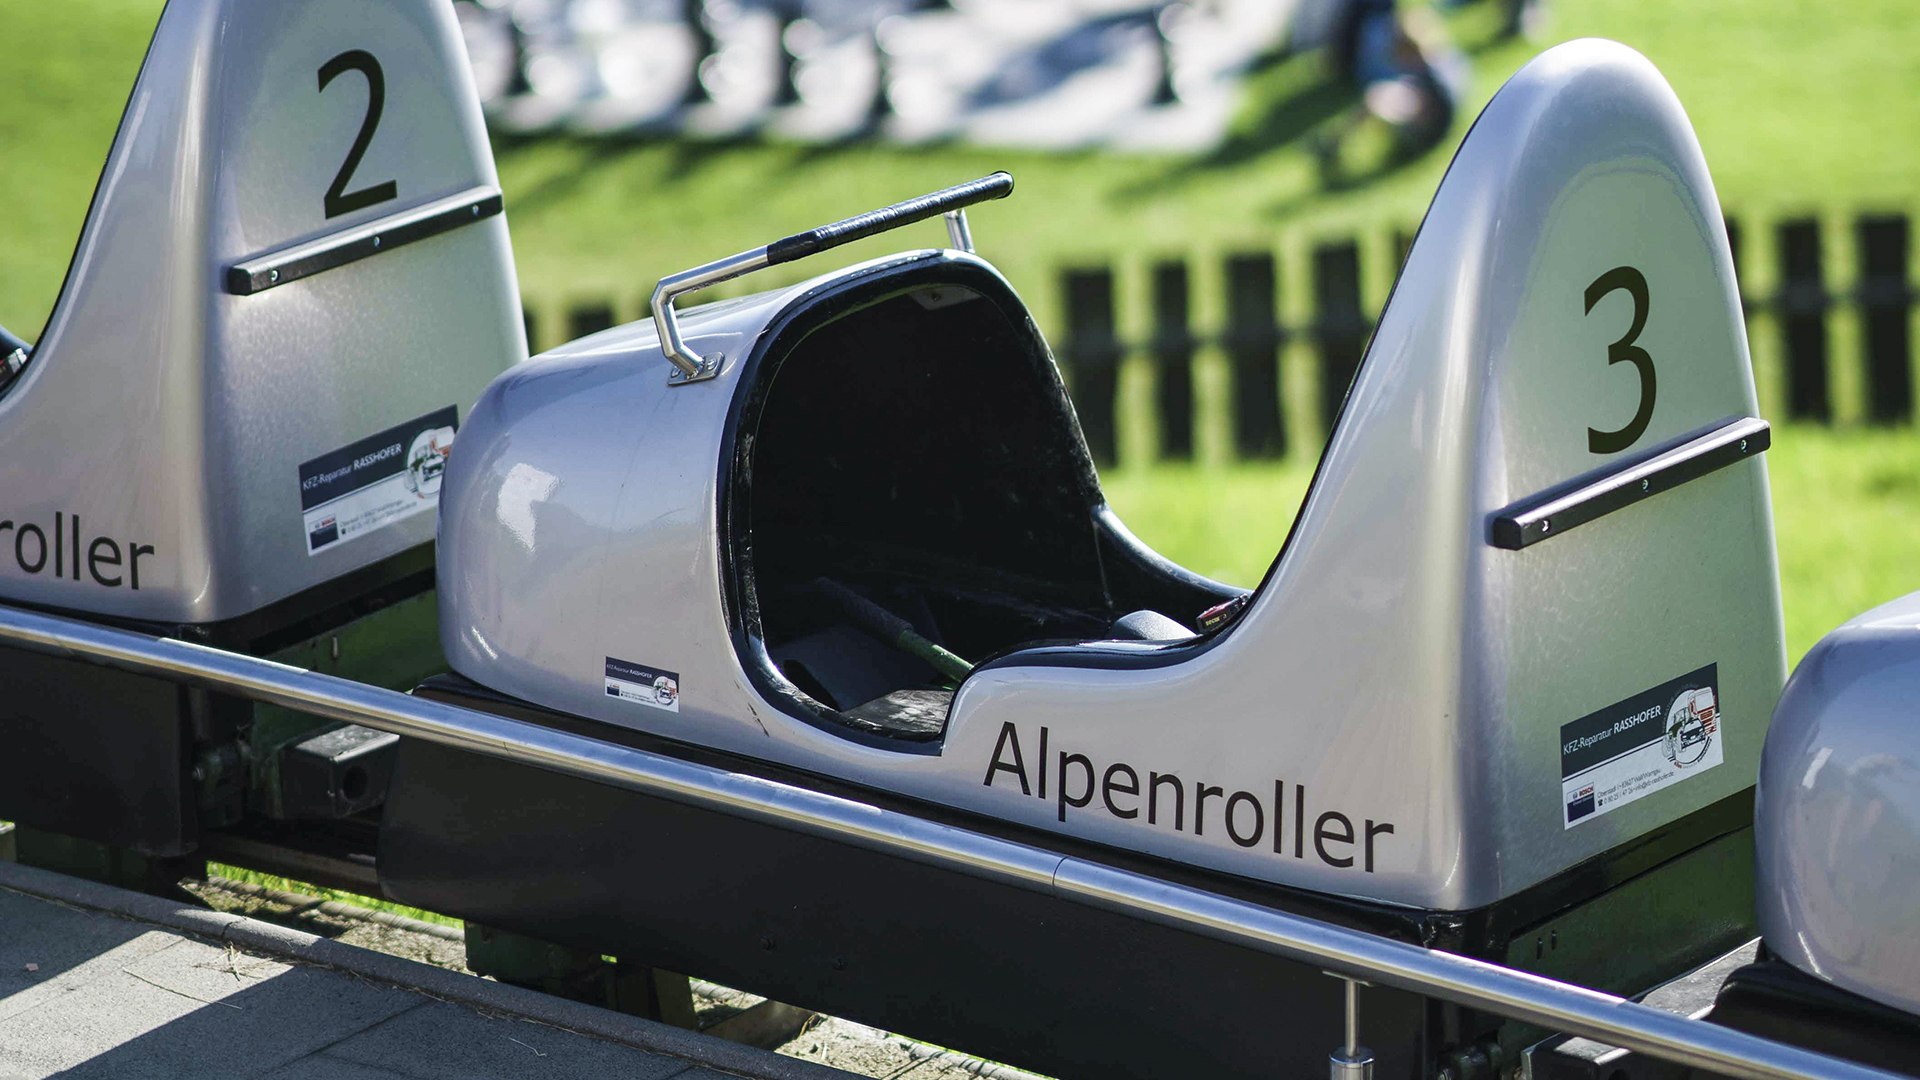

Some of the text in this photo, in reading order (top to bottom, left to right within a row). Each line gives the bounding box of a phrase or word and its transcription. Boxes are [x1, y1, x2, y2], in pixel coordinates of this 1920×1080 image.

[317, 49, 398, 220] 2
[1583, 265, 1658, 456] 3
[353, 442, 402, 471] RASSHOFER
[983, 720, 1395, 873] Alpenroller
[1563, 727, 1613, 756] KFZ-Reparatur
[1613, 705, 1662, 734] RASSHOFER
